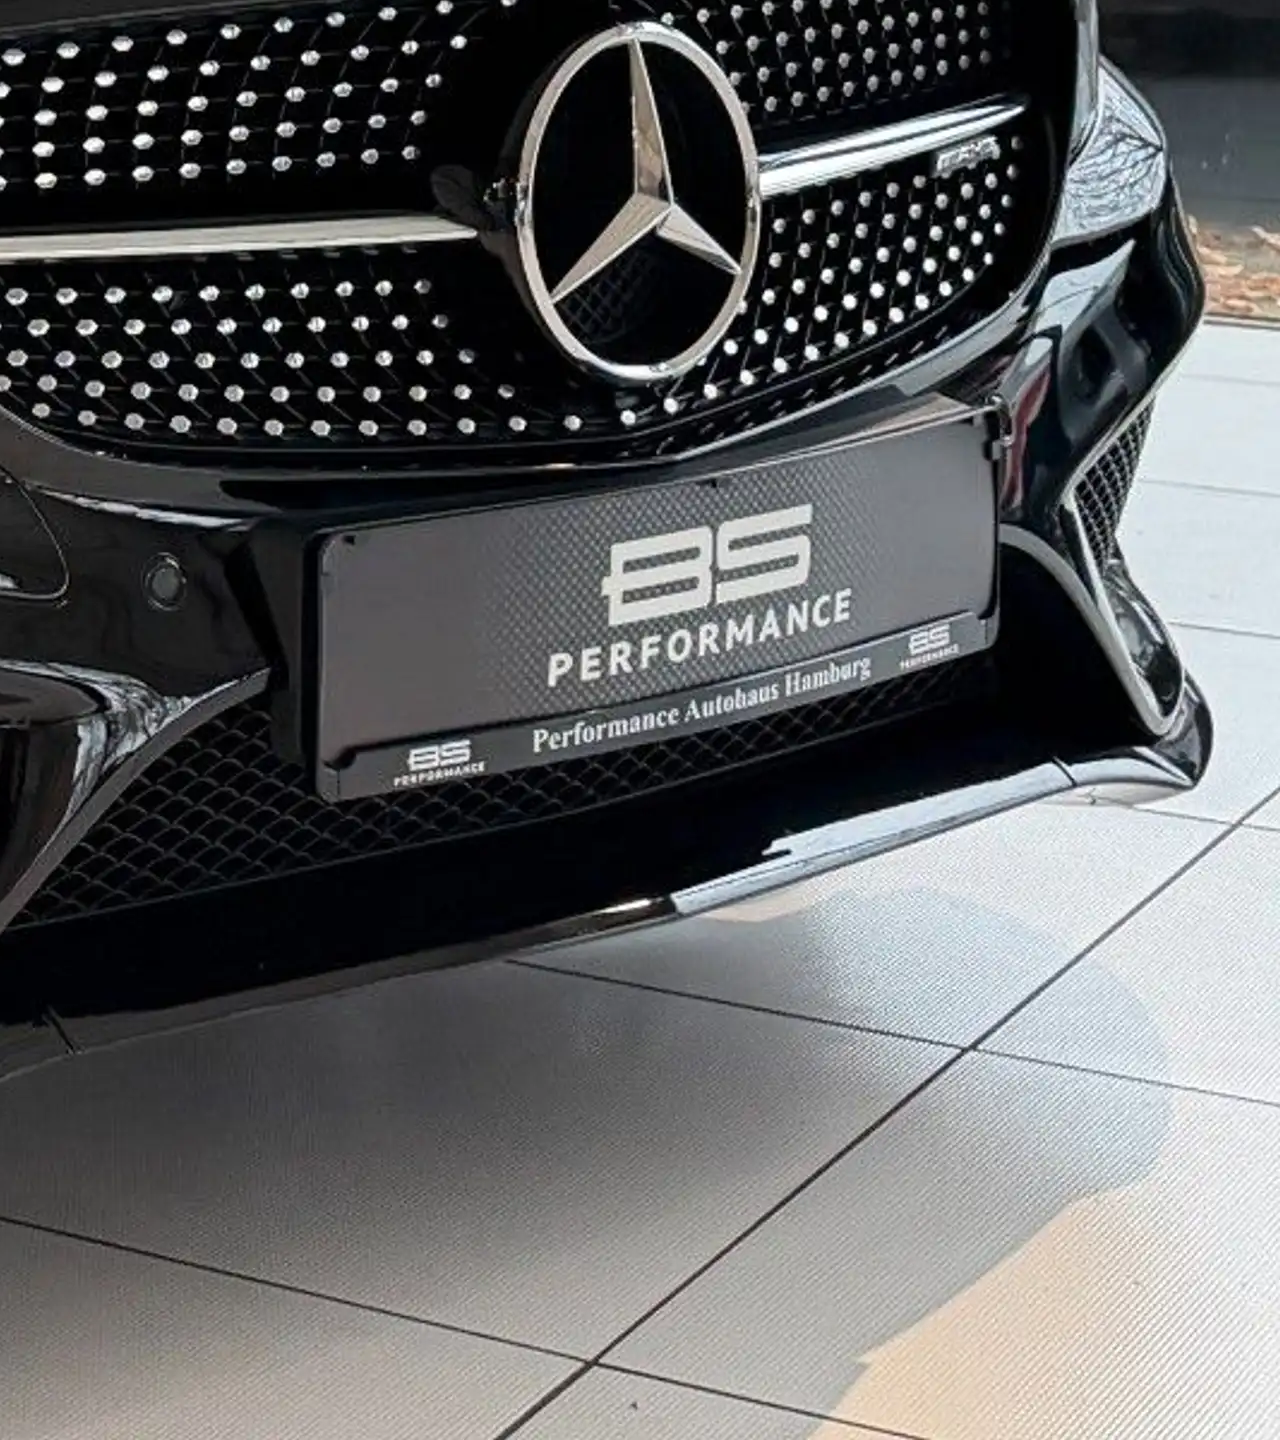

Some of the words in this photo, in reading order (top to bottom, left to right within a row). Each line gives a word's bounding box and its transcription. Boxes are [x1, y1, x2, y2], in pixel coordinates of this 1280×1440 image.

[547, 588, 852, 688] PERFORMANCE
[532, 707, 679, 753] Performance
[683, 681, 780, 723] Autohaus
[784, 656, 872, 697] Hamburg
